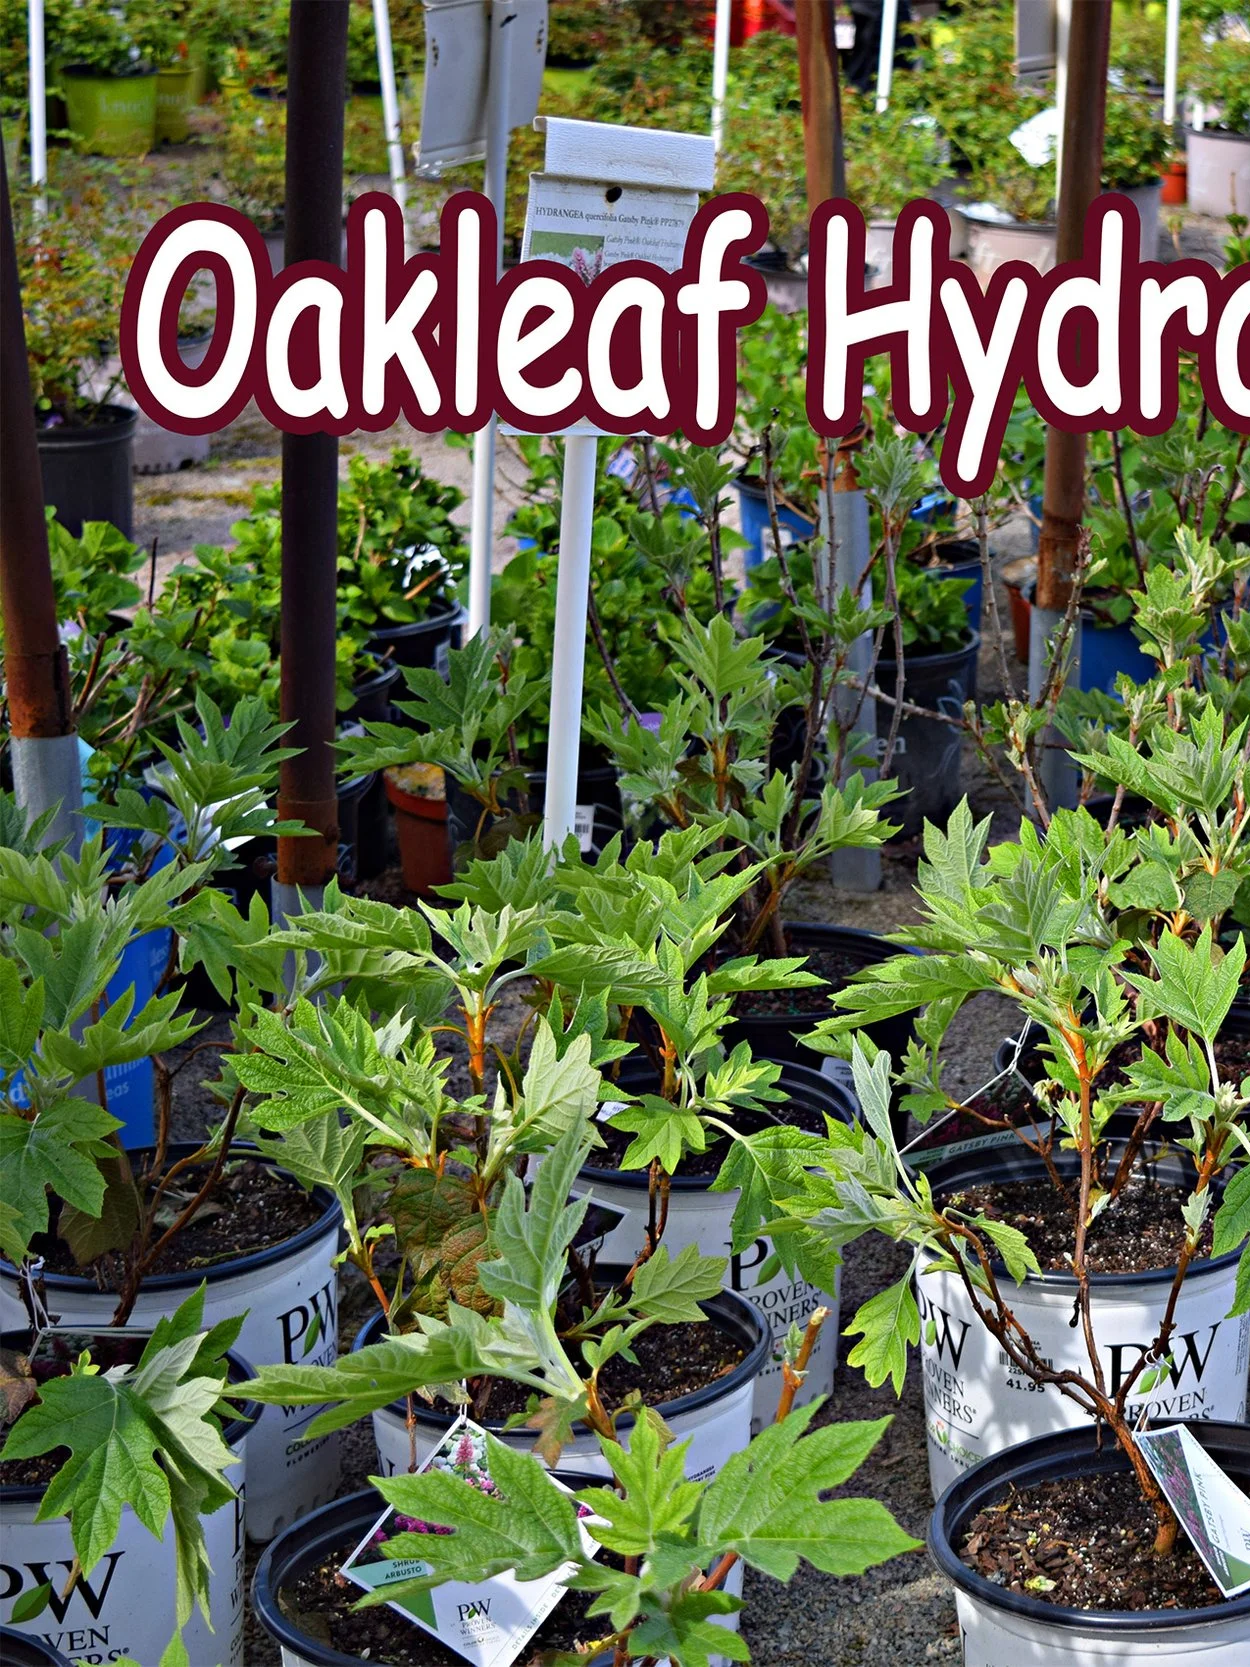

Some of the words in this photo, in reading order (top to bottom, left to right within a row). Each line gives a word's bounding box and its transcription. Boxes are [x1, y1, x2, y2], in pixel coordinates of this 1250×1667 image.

[535, 206, 584, 219] HYDRANGEA
[618, 213, 640, 225] Gatsby
[948, 1138, 989, 1154] GATSBY
[990, 1132, 1016, 1146] PINK
[749, 1280, 815, 1309] ROVEN
[1006, 1378, 1046, 1393] 41.95
[1128, 1387, 1206, 1420] ROVEN
[1202, 1502, 1221, 1544] GATSBY
[384, 1566, 422, 1580] ARBUSTO
[456, 1598, 492, 1622] PW
[511, 1623, 533, 1650] DETAILS
[530, 1603, 549, 1627] INSIDE
